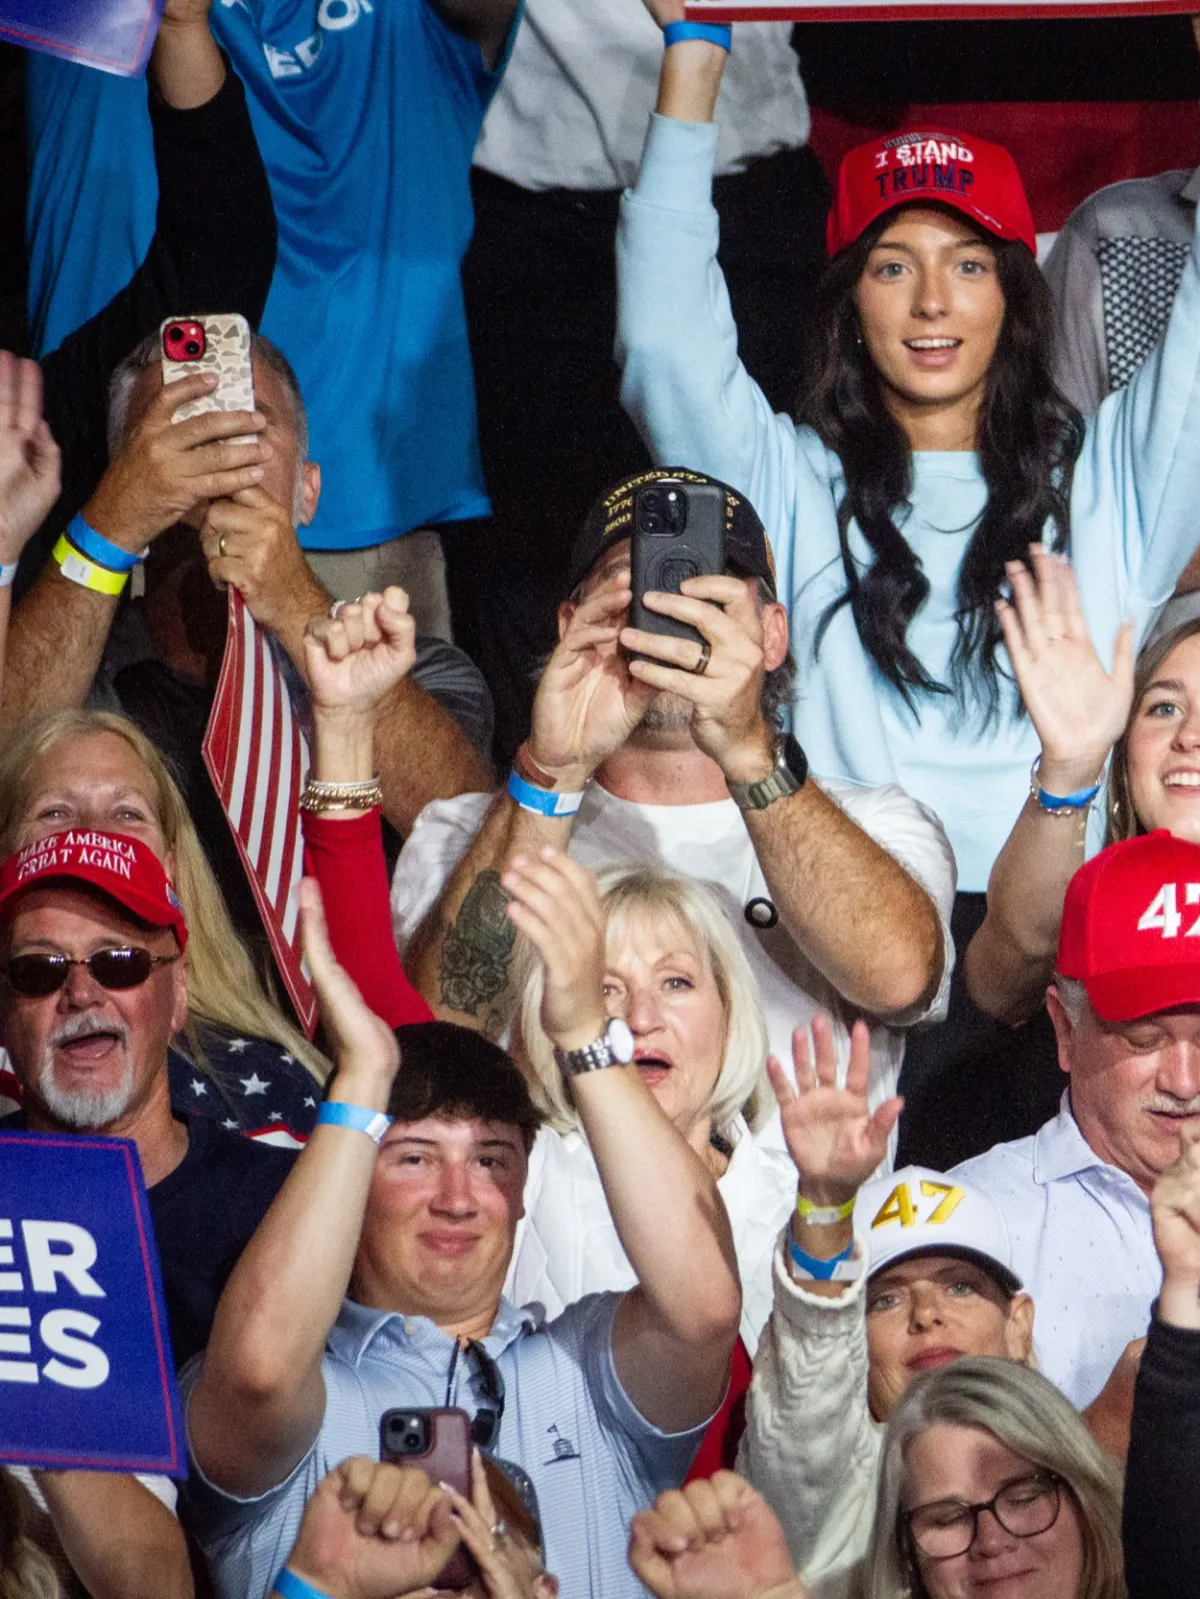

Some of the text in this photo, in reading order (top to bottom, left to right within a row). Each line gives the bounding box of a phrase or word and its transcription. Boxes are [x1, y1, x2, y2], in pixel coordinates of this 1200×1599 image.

[875, 151, 889, 168] I
[895, 139, 974, 163] STAND
[875, 163, 975, 199] TRUMP
[602, 471, 670, 507] UNITED
[17, 831, 137, 866] MAKE AMERICA
[18, 847, 131, 881] GREAT AGAIN
[870, 1180, 966, 1230] 47
